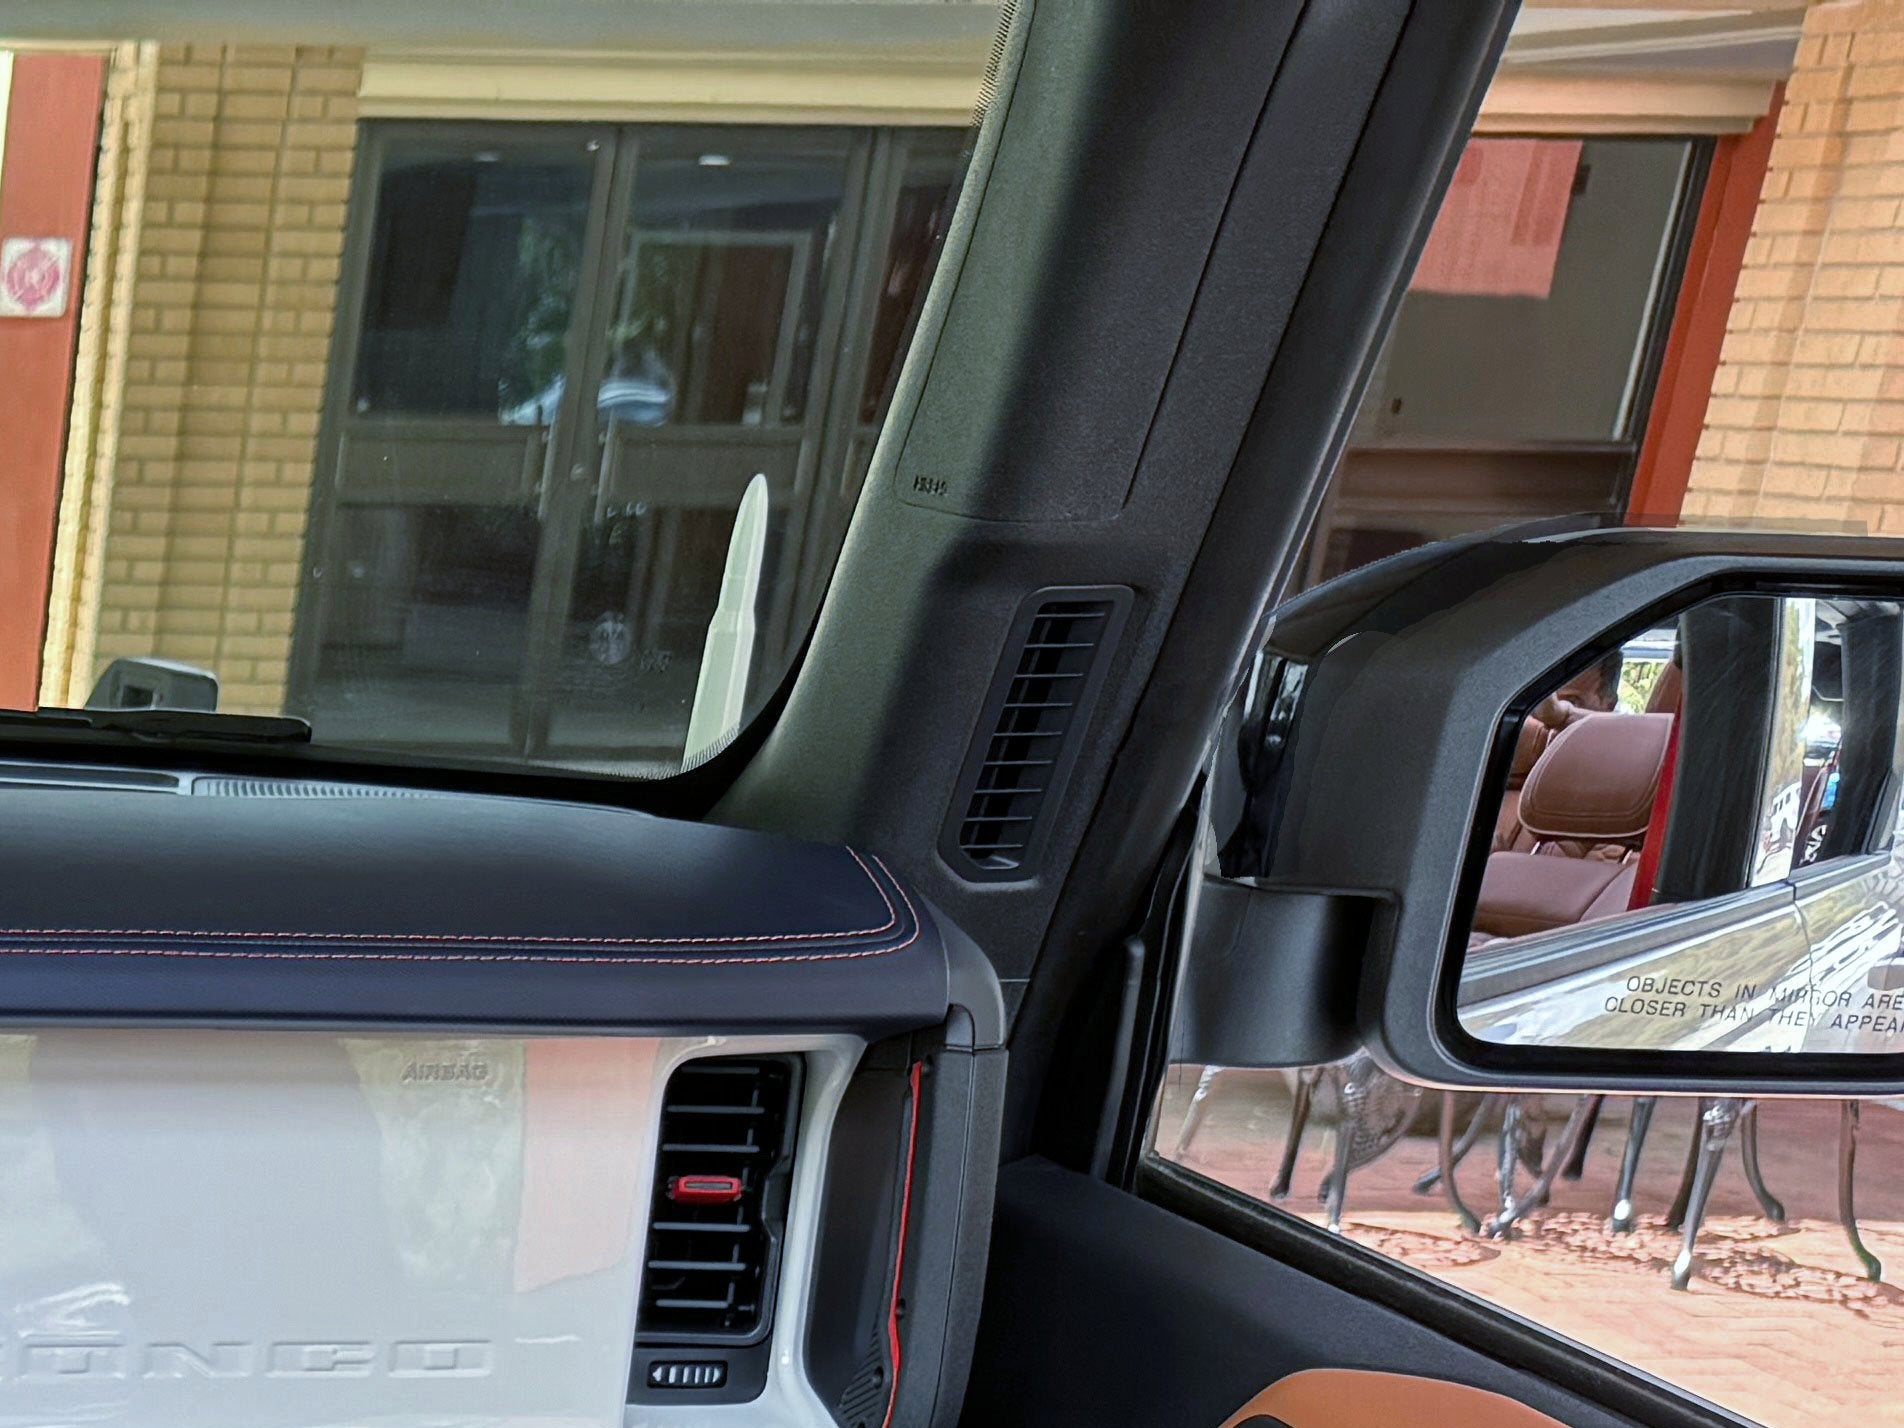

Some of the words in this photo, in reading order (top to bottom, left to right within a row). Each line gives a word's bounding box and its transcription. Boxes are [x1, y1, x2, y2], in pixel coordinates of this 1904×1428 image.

[1626, 975, 1722, 999] OBJECTS
[1735, 984, 1757, 1000] IN
[1862, 993, 1904, 1011] ARE
[1604, 996, 1686, 1018] CLOSER
[1700, 1003, 1754, 1023] THAN
[1770, 1008, 1822, 1027] THEY
[400, 1061, 489, 1081] AIRBAG
